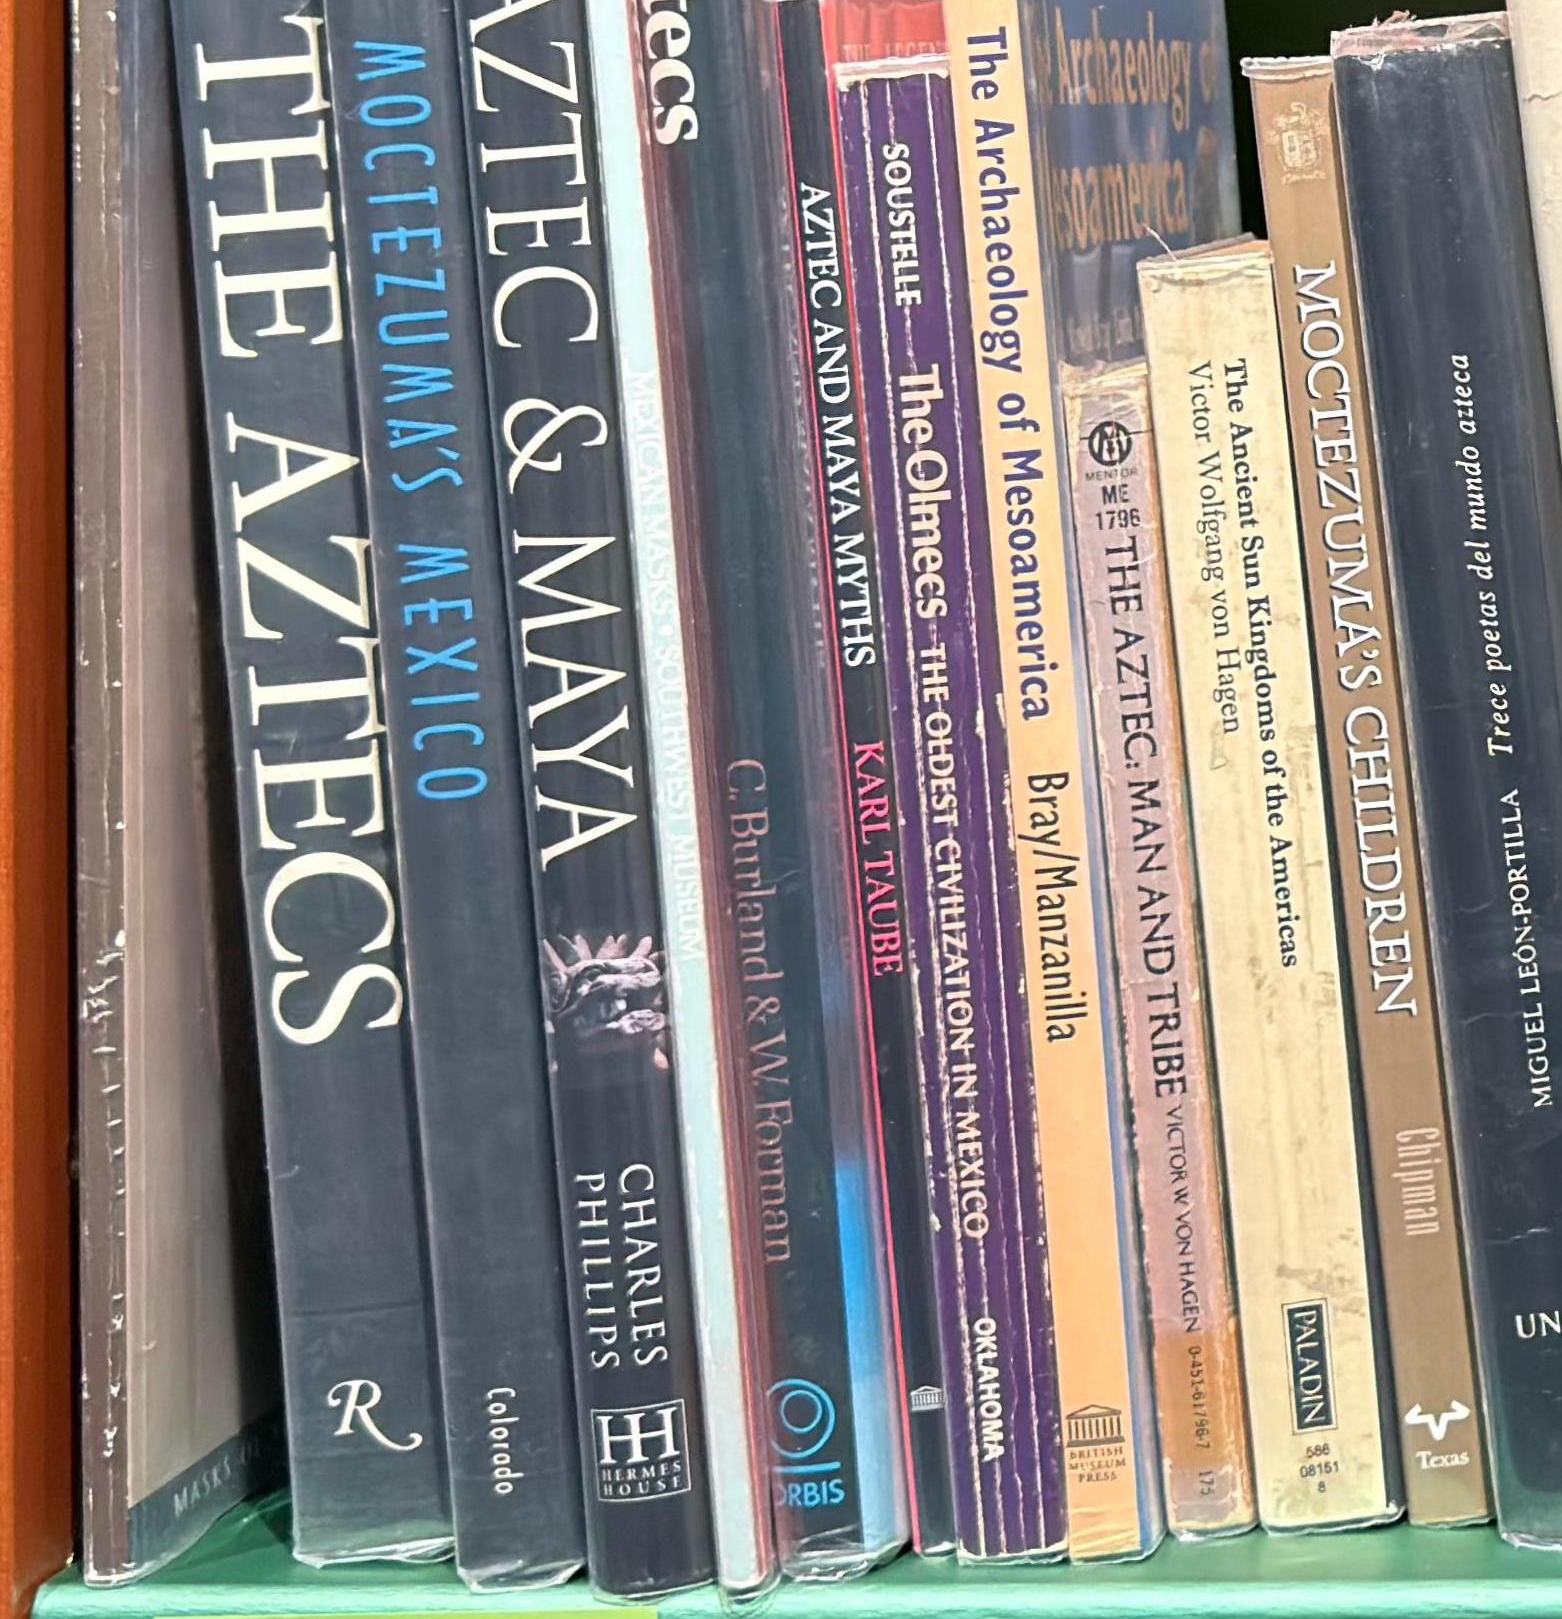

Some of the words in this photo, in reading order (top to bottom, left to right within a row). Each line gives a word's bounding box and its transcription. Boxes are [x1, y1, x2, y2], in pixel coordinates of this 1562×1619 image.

[966, 26, 1009, 100] The
[196, 15, 343, 359] THE
[883, 143, 922, 307] SOUSTELLE
[353, 40, 463, 493] MOCTEZUMA'S
[800, 182, 842, 309] AZTEC
[974, 119, 1029, 374] Archaeology
[814, 318, 851, 404] AND
[899, 363, 940, 441] The
[997, 393, 1042, 434] of
[1224, 359, 1247, 412] The
[1451, 355, 1477, 433] azteca
[502, 398, 608, 494] &
[820, 412, 861, 524] MAYA
[1085, 468, 1138, 481] MENTOR
[1102, 484, 1130, 505] ME
[1230, 423, 1258, 531] Ancient
[1462, 445, 1490, 533] mundo
[905, 448, 948, 618] Olmecs
[1095, 509, 1141, 530] 1796
[1241, 536, 1264, 589] Sun
[1467, 537, 1493, 581] del
[833, 533, 876, 667] MYTHS
[1001, 449, 1059, 722] Mesoamerica
[1294, 261, 1382, 691] MOCTEZUMA'S
[1345, 706, 1418, 1017] CHILDREN
[1479, 588, 1514, 674] poetas
[398, 544, 487, 799] MEXICO
[512, 529, 637, 871] MAYA
[1243, 596, 1278, 743] Kingdoms
[1488, 681, 1515, 758] Trece
[226, 412, 402, 1046] AZTECS
[1261, 749, 1280, 779] of
[853, 741, 895, 845] KARL
[1264, 781, 1284, 827] the
[865, 848, 903, 977] TAUBE
[1018, 771, 1088, 1043] Bray/Manzanilla
[1270, 835, 1298, 969] Americas
[1500, 789, 1542, 995] LEÓN-PORTILLA
[1523, 1002, 1553, 1108] MIGUEL
[1391, 1126, 1441, 1237] Chipman
[574, 1172, 621, 1370] PHILLIPS
[620, 1163, 668, 1366] CHARLES
[973, 1316, 1004, 1462] OKLAHOMA
[1292, 1307, 1327, 1425] PALADIN
[487, 1387, 525, 1495] Colorado
[603, 1461, 681, 1481] HERMES
[603, 1477, 683, 1496] HOUSE
[1299, 1460, 1340, 1478] 08151
[1305, 1442, 1331, 1459] 586
[1415, 1449, 1469, 1470] Texas
